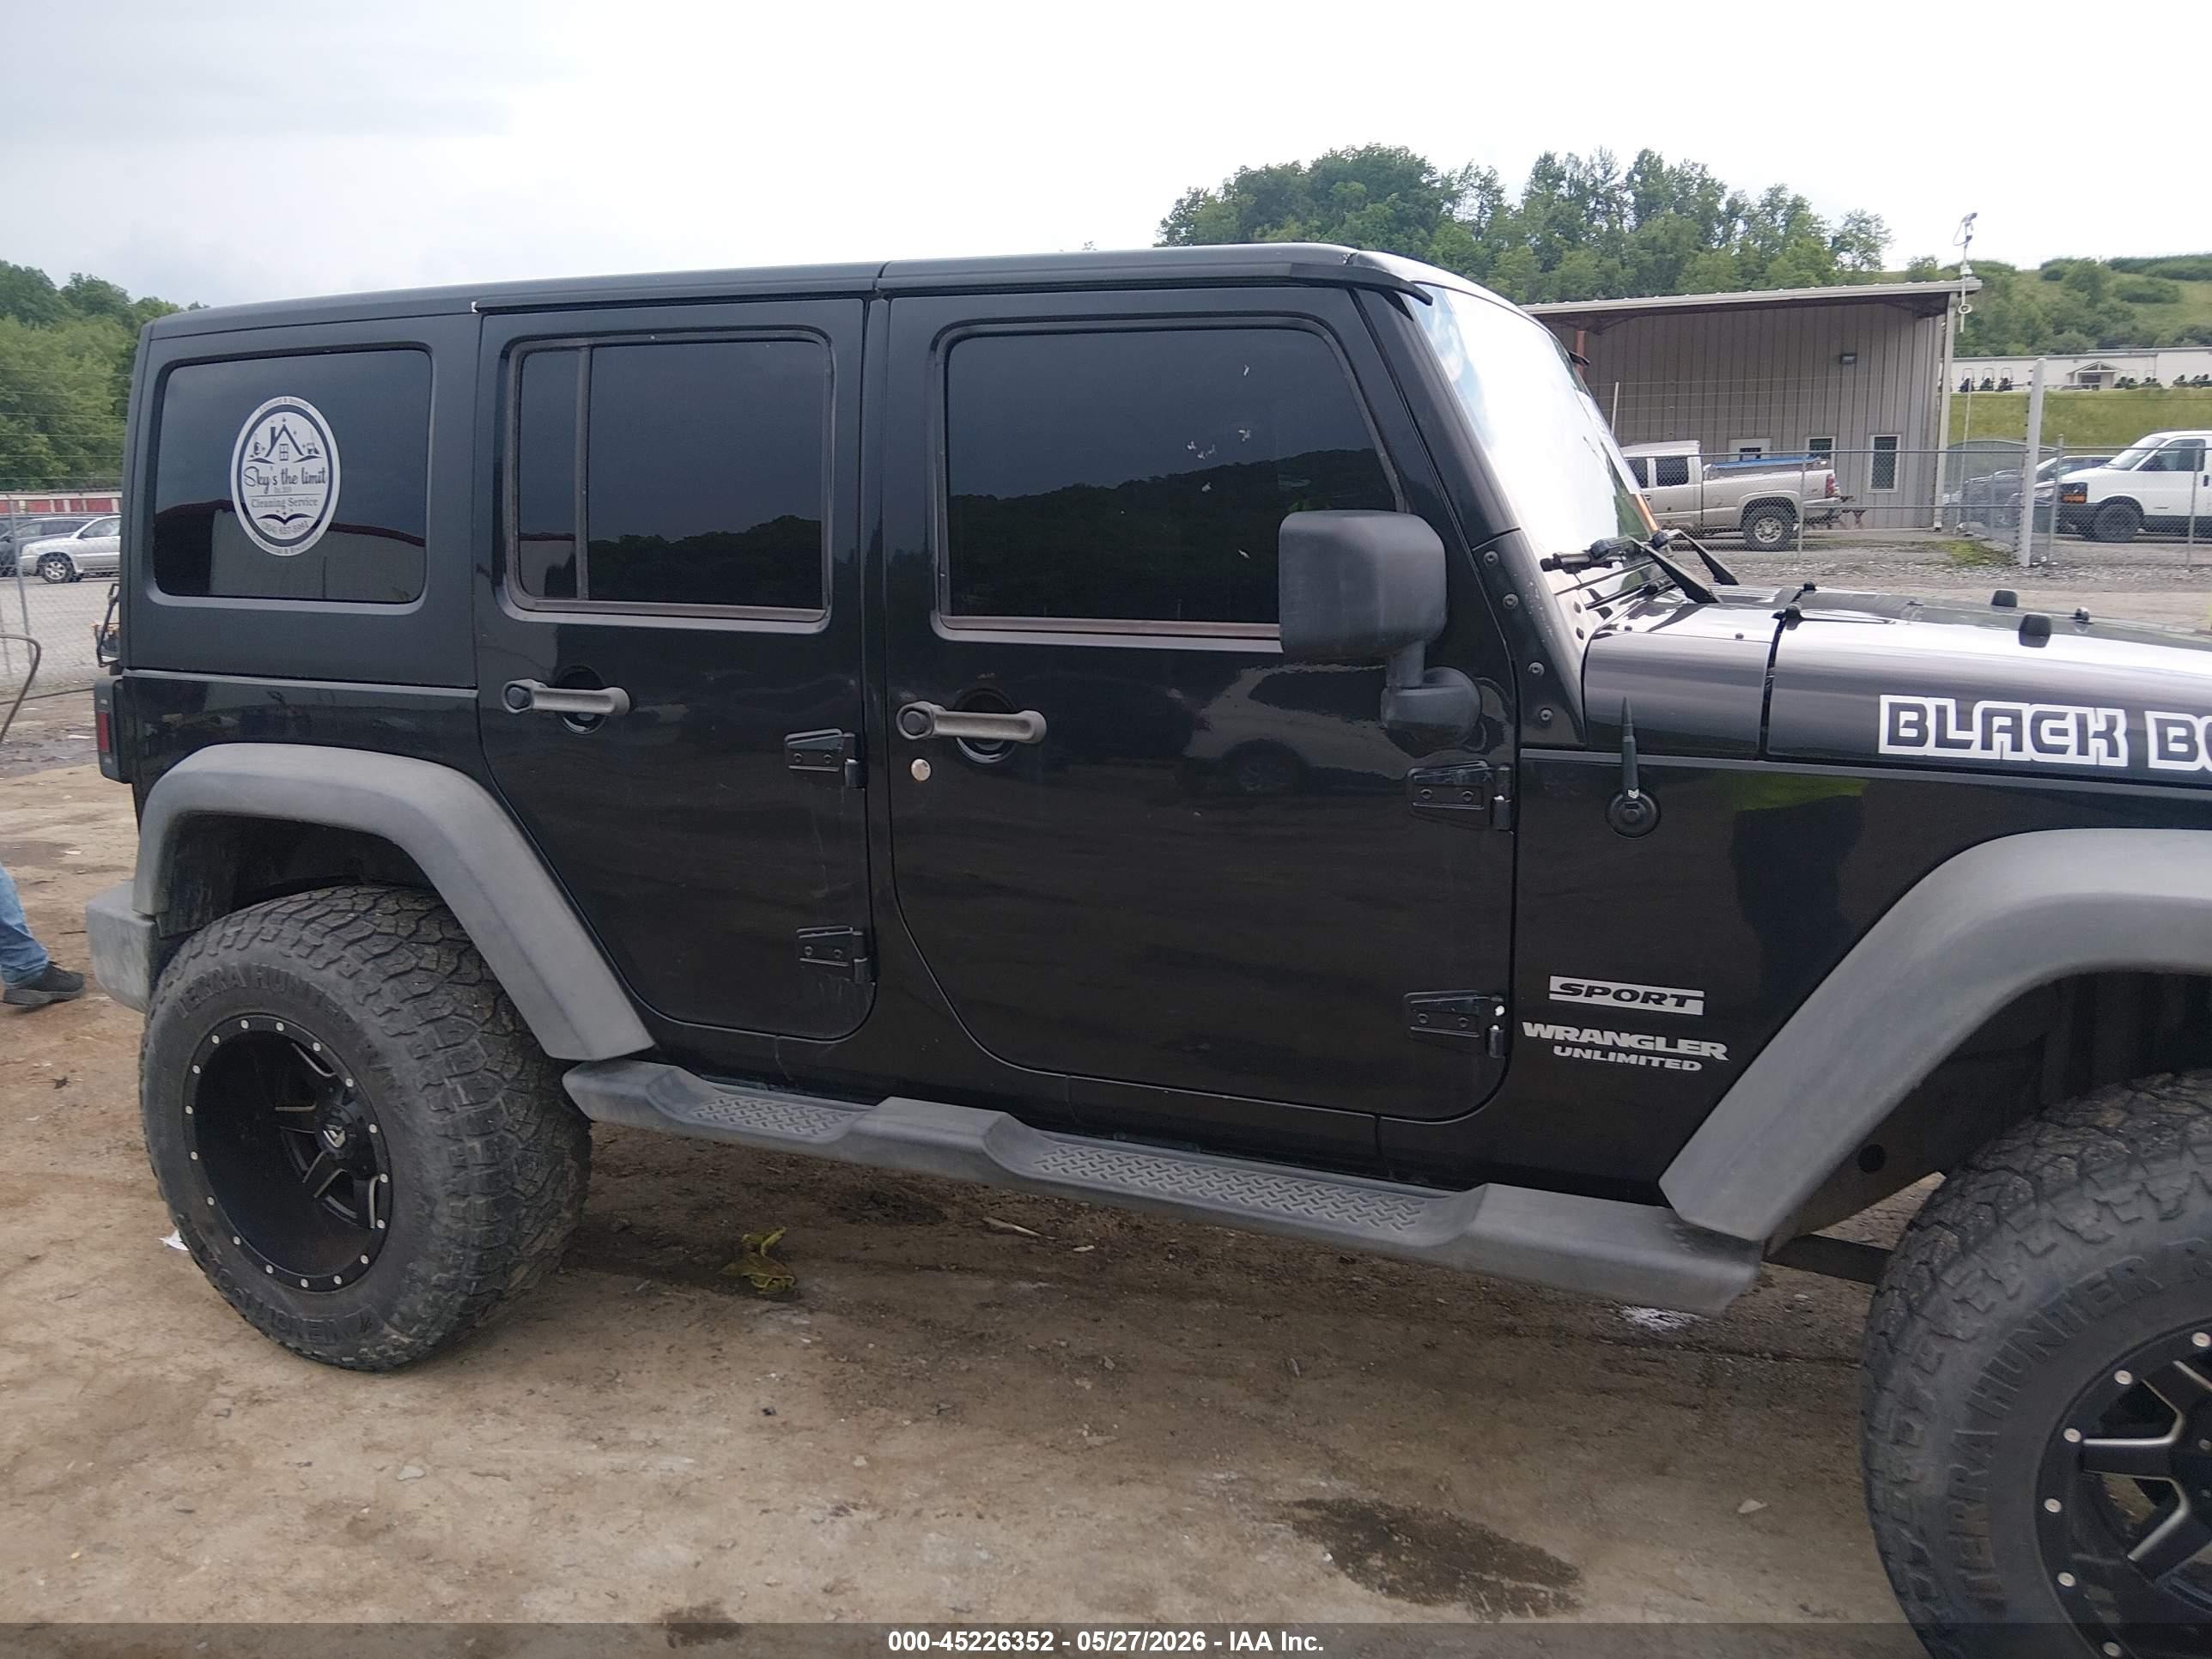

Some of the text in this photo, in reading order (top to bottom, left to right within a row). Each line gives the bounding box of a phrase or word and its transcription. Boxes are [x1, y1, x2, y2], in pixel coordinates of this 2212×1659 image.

[243, 465, 277, 495] Sky's
[281, 467, 299, 485] the
[301, 466, 326, 485] limit
[251, 496, 319, 510] Cleaning Service
[1878, 694, 2212, 772] BLACK B
[1551, 982, 1705, 1008] SPORT
[1522, 1021, 1729, 1061] WRANGLER
[1553, 1045, 1703, 1072] UNLIMITED
[1965, 1255, 2164, 1420] HUNTER
